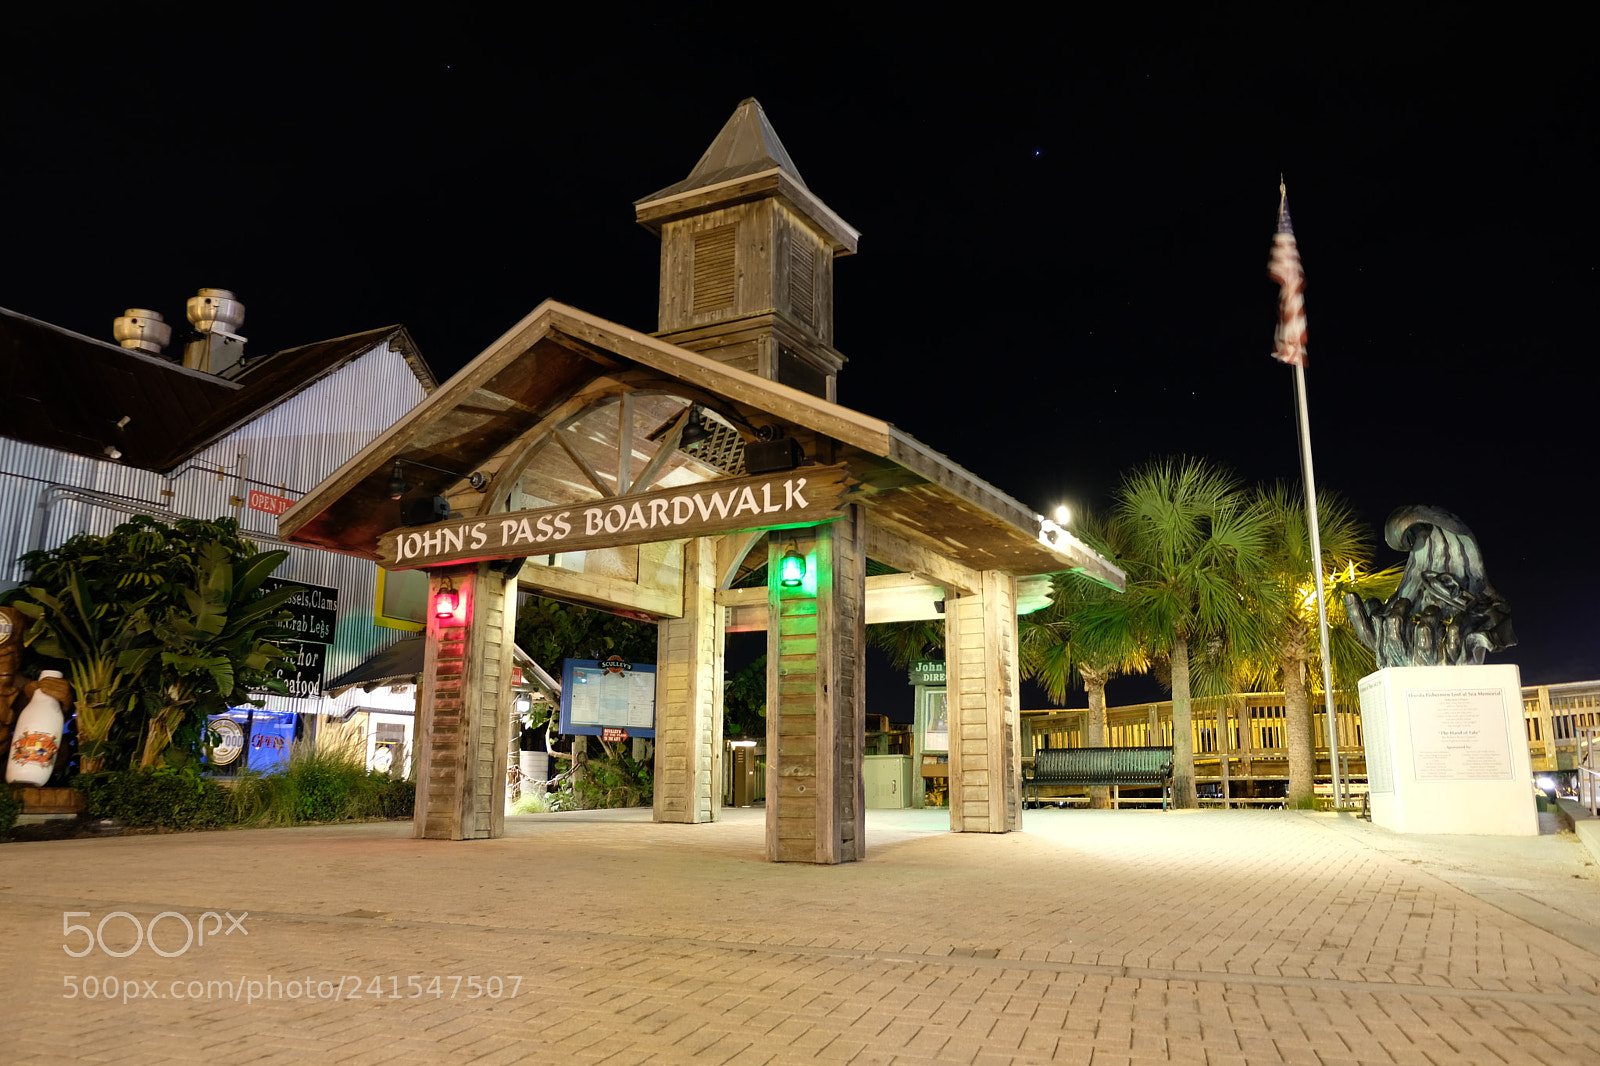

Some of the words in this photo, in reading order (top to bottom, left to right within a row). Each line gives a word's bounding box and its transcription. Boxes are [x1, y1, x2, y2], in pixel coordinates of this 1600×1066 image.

[252, 493, 277, 512] OPEN
[394, 522, 488, 563] JOHN'S
[501, 511, 571, 546] PASS
[584, 477, 810, 536] BOARDWALK
[310, 615, 330, 638] Legs
[602, 661, 632, 670] SCULLEY'S
[923, 673, 947, 682] DIRE
